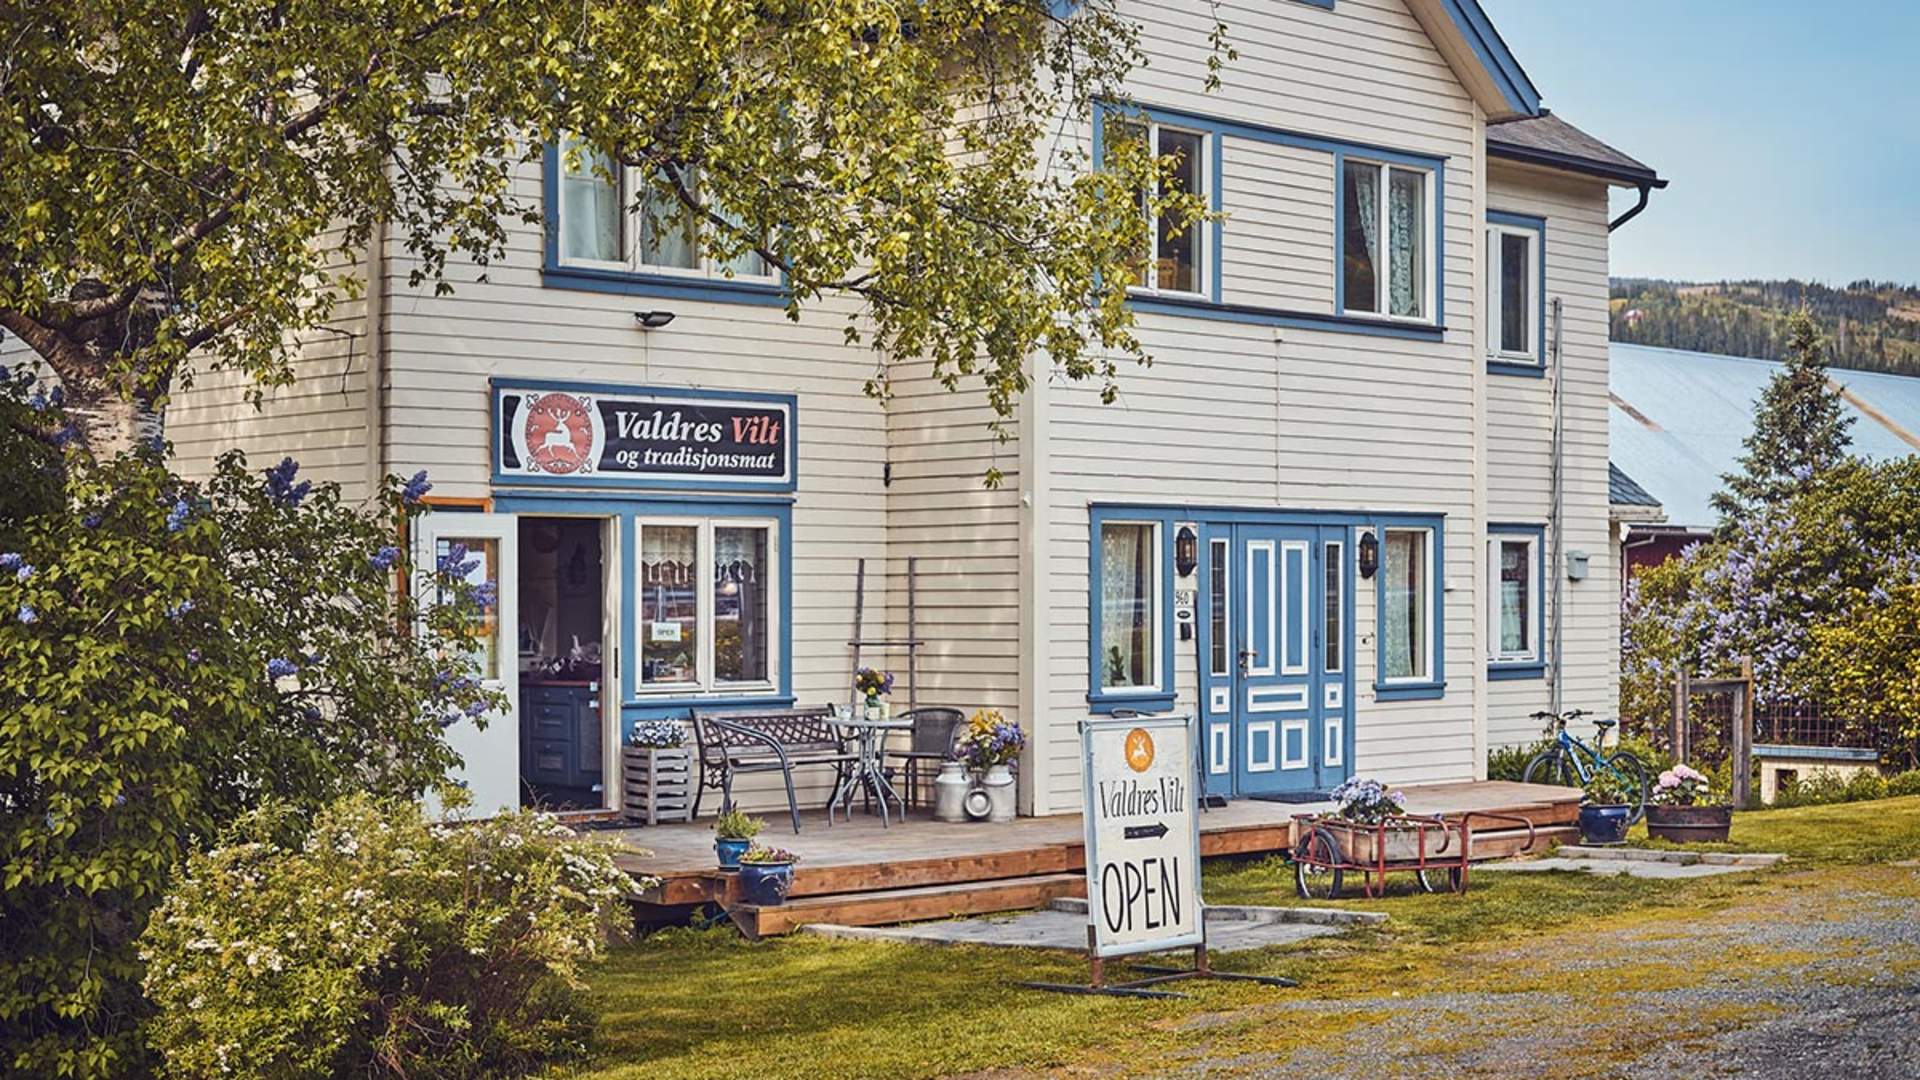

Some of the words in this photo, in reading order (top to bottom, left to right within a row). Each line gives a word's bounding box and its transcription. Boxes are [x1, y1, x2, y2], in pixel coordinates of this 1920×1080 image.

[615, 410, 722, 443] Valdres
[731, 415, 780, 445] Vilt
[616, 449, 639, 469] og
[644, 447, 776, 470] tradisjonsmat
[1100, 779, 1158, 818] Valdres
[1102, 856, 1180, 934] OPEN
